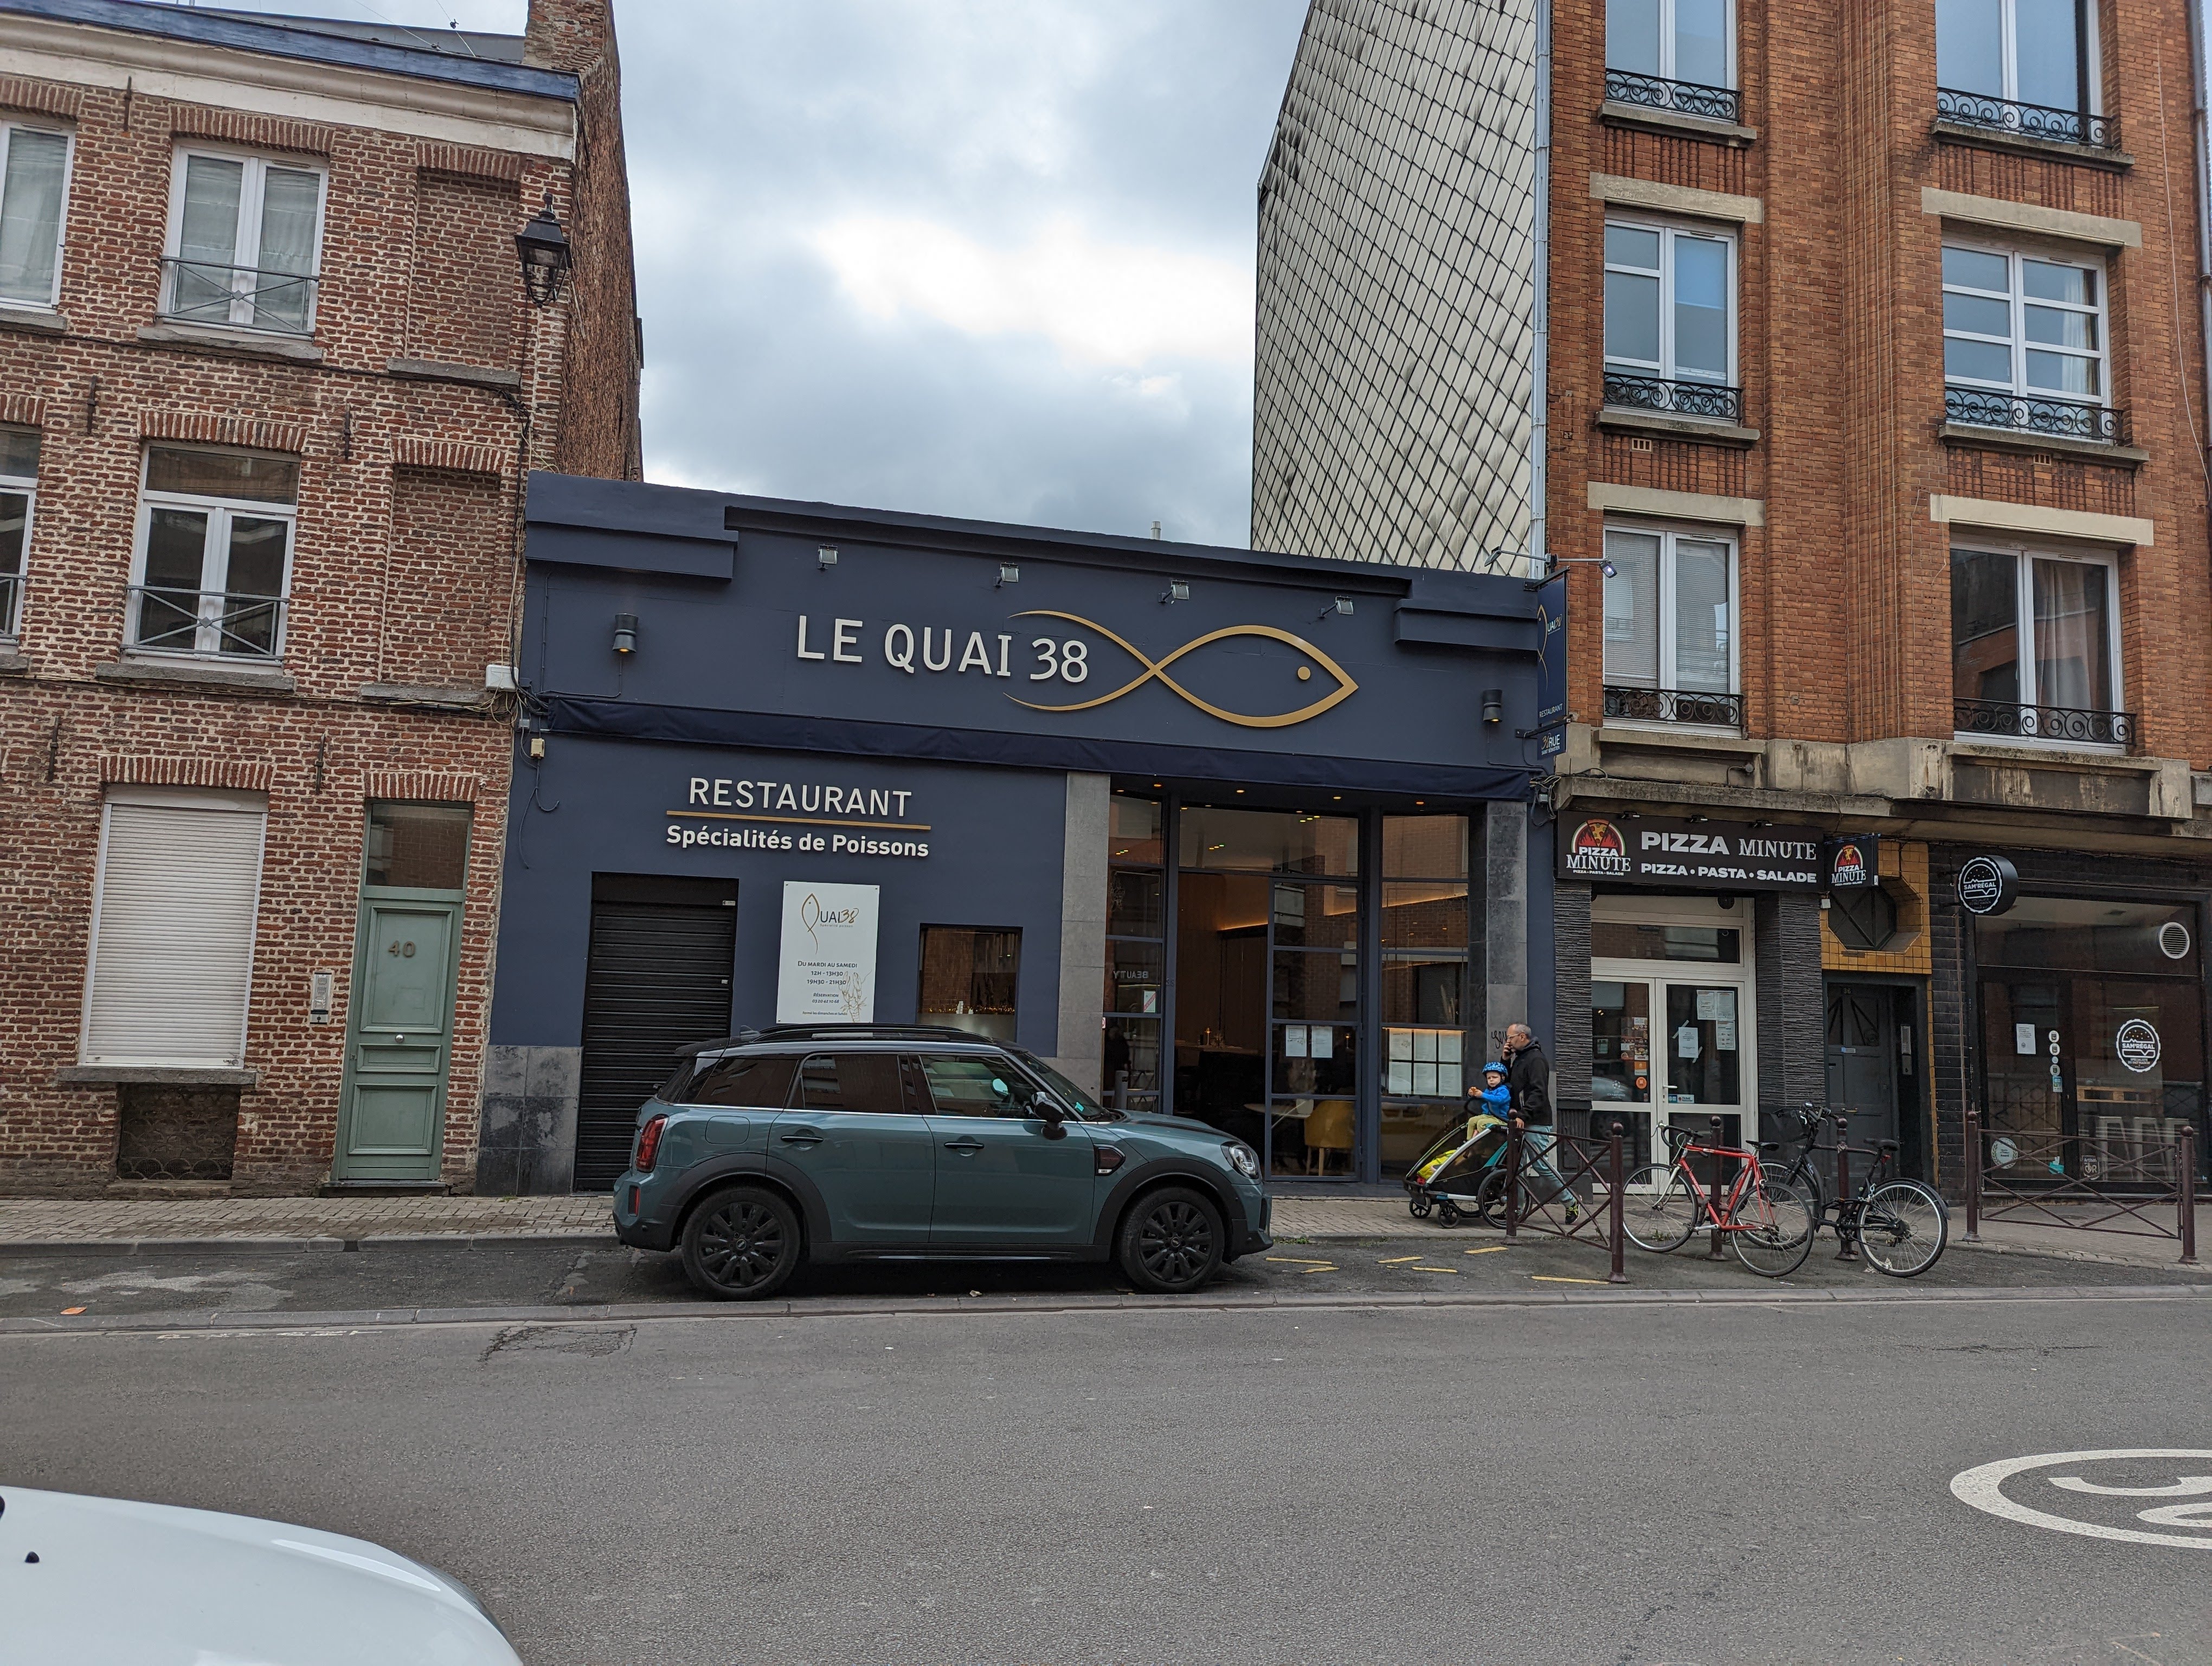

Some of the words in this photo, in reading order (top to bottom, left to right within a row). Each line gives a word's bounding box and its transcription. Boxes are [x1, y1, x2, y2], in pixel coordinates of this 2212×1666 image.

[797, 615, 863, 663] LE
[885, 623, 1012, 677] QUAI
[1030, 638, 1088, 683] 38
[1539, 703, 1563, 717] RESTAURANT
[1548, 734, 1560, 748] RUE
[689, 777, 912, 817] RESTAURANT
[666, 824, 793, 851] Spécialités
[799, 832, 826, 853] de
[832, 834, 929, 857] Poissons
[1641, 831, 1730, 855] PIZZA
[1738, 838, 1817, 861] MINUTE
[1579, 846, 1619, 857] PIZZA
[1566, 854, 1631, 872] MINUTE
[1838, 864, 1860, 873] PIZZA
[1641, 862, 1688, 876] PIZZA
[1698, 866, 1746, 880] PASTA
[1756, 869, 1817, 883] SALADE
[1831, 869, 1867, 884] MINUTE
[388, 940, 416, 957] 40
